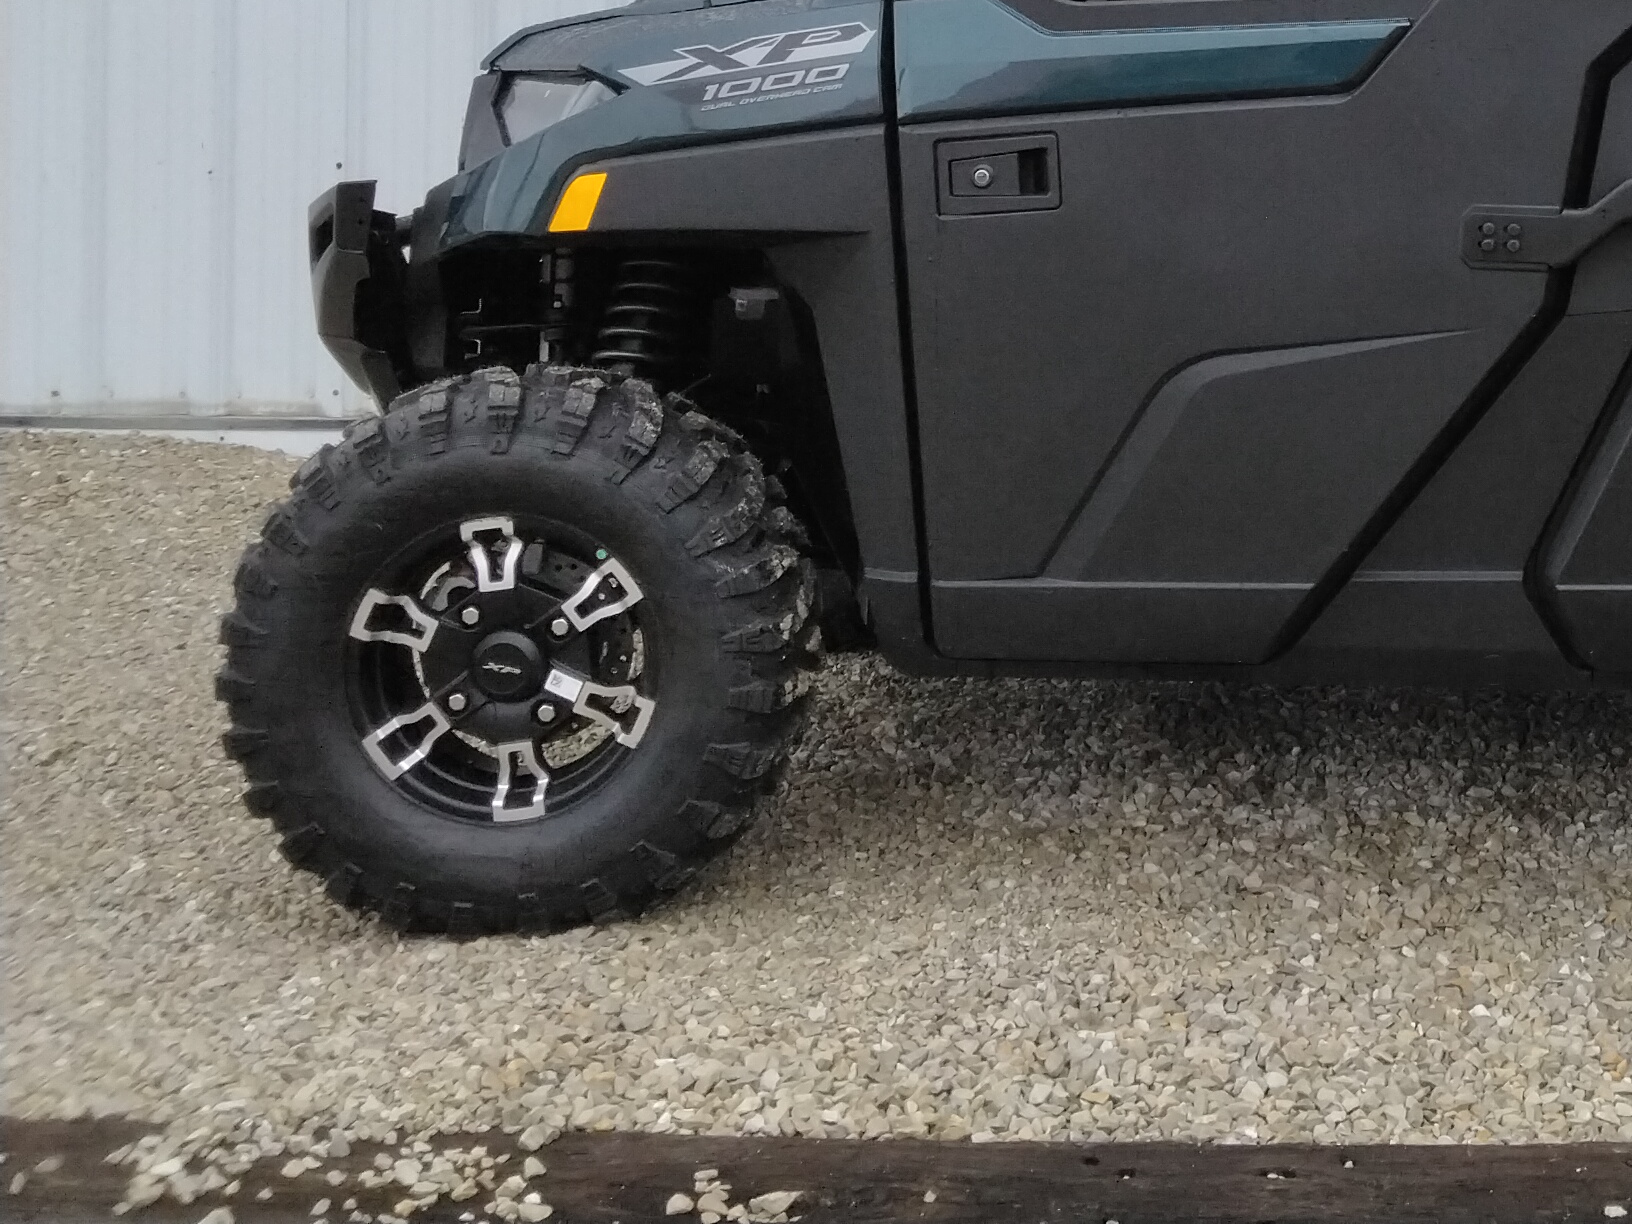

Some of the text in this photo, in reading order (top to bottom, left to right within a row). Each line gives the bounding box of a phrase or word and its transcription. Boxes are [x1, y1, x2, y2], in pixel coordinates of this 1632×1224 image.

[645, 22, 872, 85] XP
[700, 83, 843, 112] DUAL OVERHEAD CAM
[702, 63, 850, 101] 1000
